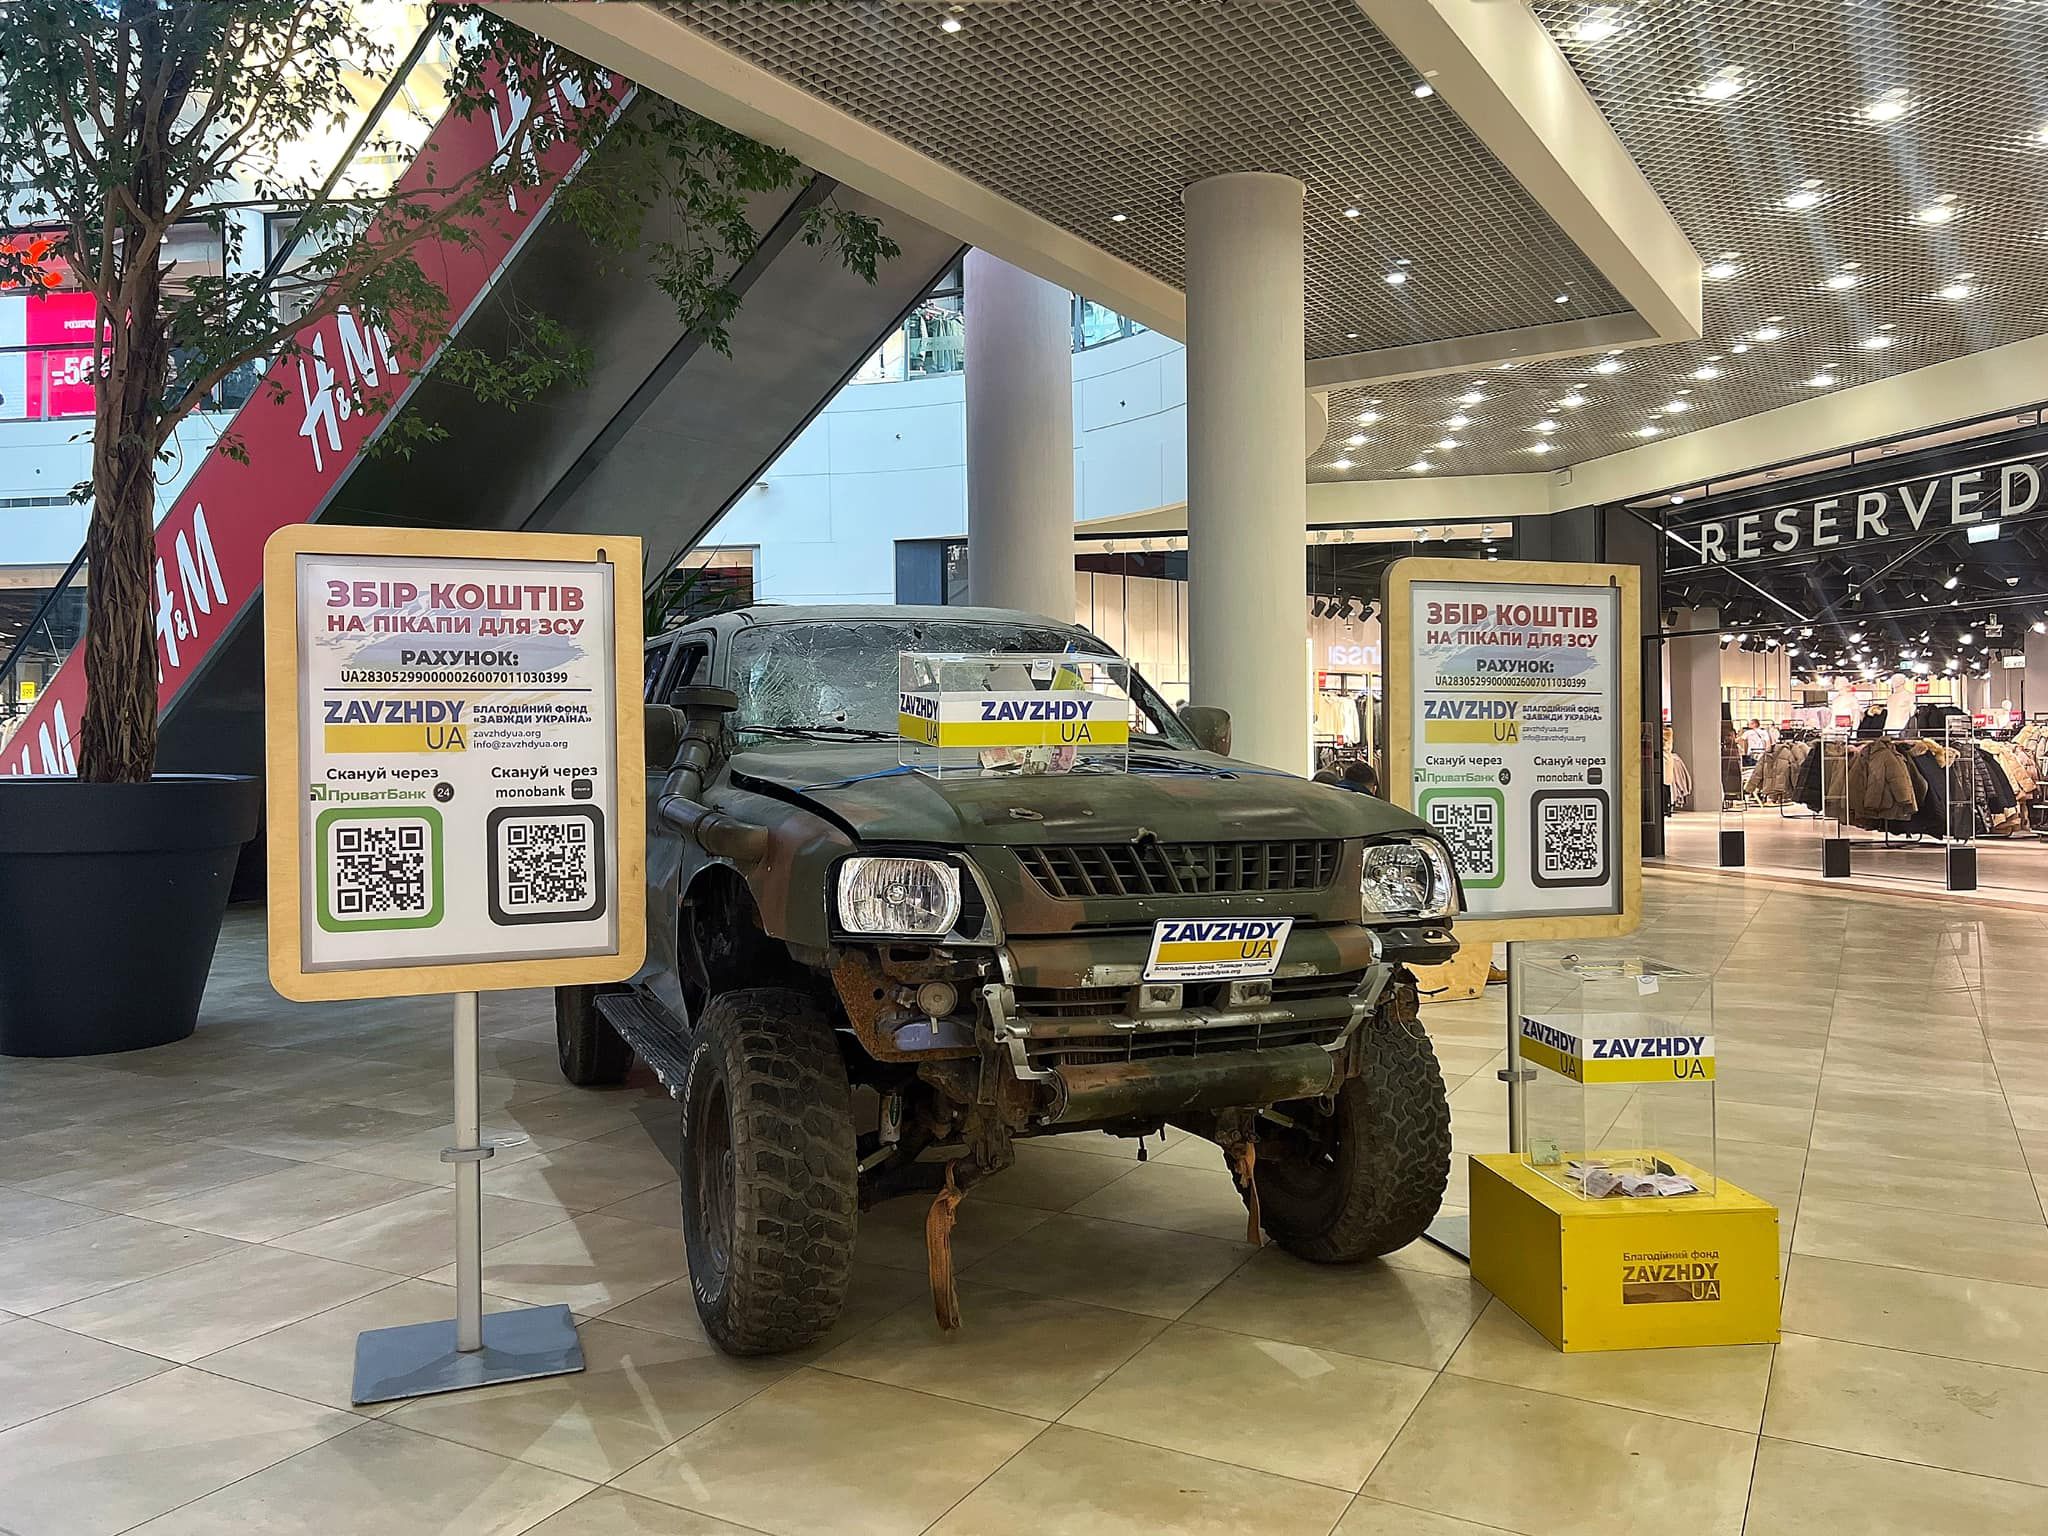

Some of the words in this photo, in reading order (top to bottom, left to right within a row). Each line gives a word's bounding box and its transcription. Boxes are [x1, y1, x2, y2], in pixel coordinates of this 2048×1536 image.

[299, 303, 400, 472] H&M
[1701, 464, 2040, 564] RESERVED
[326, 581, 418, 609] ЗБІР
[431, 583, 584, 612] КОШТІВ
[1427, 602, 1488, 626] ЗБІР
[1496, 604, 1599, 628] КОШТІВ
[328, 615, 366, 632] НА
[374, 616, 471, 634] ПІКАПИ
[478, 618, 531, 636] ДЛЯ
[539, 618, 584, 635] ЗСУ
[1427, 630, 1452, 645] НА
[1457, 631, 1522, 647] ПІКАПИ
[1527, 633, 1563, 649] ДЛЯ
[1567, 634, 1599, 648] ЗСУ
[401, 650, 519, 666] РАХУНОК:
[1476, 659, 1554, 673] РАХУНОК:
[341, 670, 568, 684] UA283052990000026007011030399
[324, 700, 465, 724] ZAVZHDY
[473, 704, 552, 714] БЛАГОДІЙНИЙ
[555, 705, 588, 714] ФОНД
[900, 694, 939, 721] ZAVZHDY
[981, 700, 1093, 721] ZAVZHDY
[1424, 700, 1518, 720] ZAVZHDY
[473, 715, 532, 724] «ЗАВЖДИ
[535, 712, 592, 723] УКРАЇНА»
[426, 726, 466, 750] UA
[473, 730, 541, 739] zavzhdyua.org
[926, 723, 939, 743] UA
[1061, 723, 1092, 743] UA
[1493, 722, 1518, 741] UA
[473, 740, 568, 750] info@zavzhdyua.org
[1425, 755, 1466, 767] Скануй
[1469, 757, 1502, 767] через
[1534, 755, 1573, 767] Скануй
[1575, 757, 1606, 767] через
[326, 766, 387, 781] Скануй
[391, 768, 439, 783] через
[491, 765, 549, 780] Скануй
[553, 766, 598, 781] через
[1537, 772, 1583, 782] monobank
[327, 788, 426, 803] ПриватБанк
[436, 786, 450, 799] 24
[495, 785, 566, 799] monobank
[1161, 922, 1284, 942] ZAVZHDY
[1241, 941, 1273, 959] UA
[1522, 1018, 1577, 1055] ZAVZHDY
[1593, 1036, 1705, 1058] ZAVZHDY
[1559, 1054, 1577, 1078] UA
[1673, 1059, 1705, 1079] UA
[1623, 1250, 1688, 1262] Благодійний
[1690, 1250, 1719, 1261] фонд
[1623, 1263, 1719, 1282] ZAVZHDY
[1691, 1282, 1720, 1300] UA
